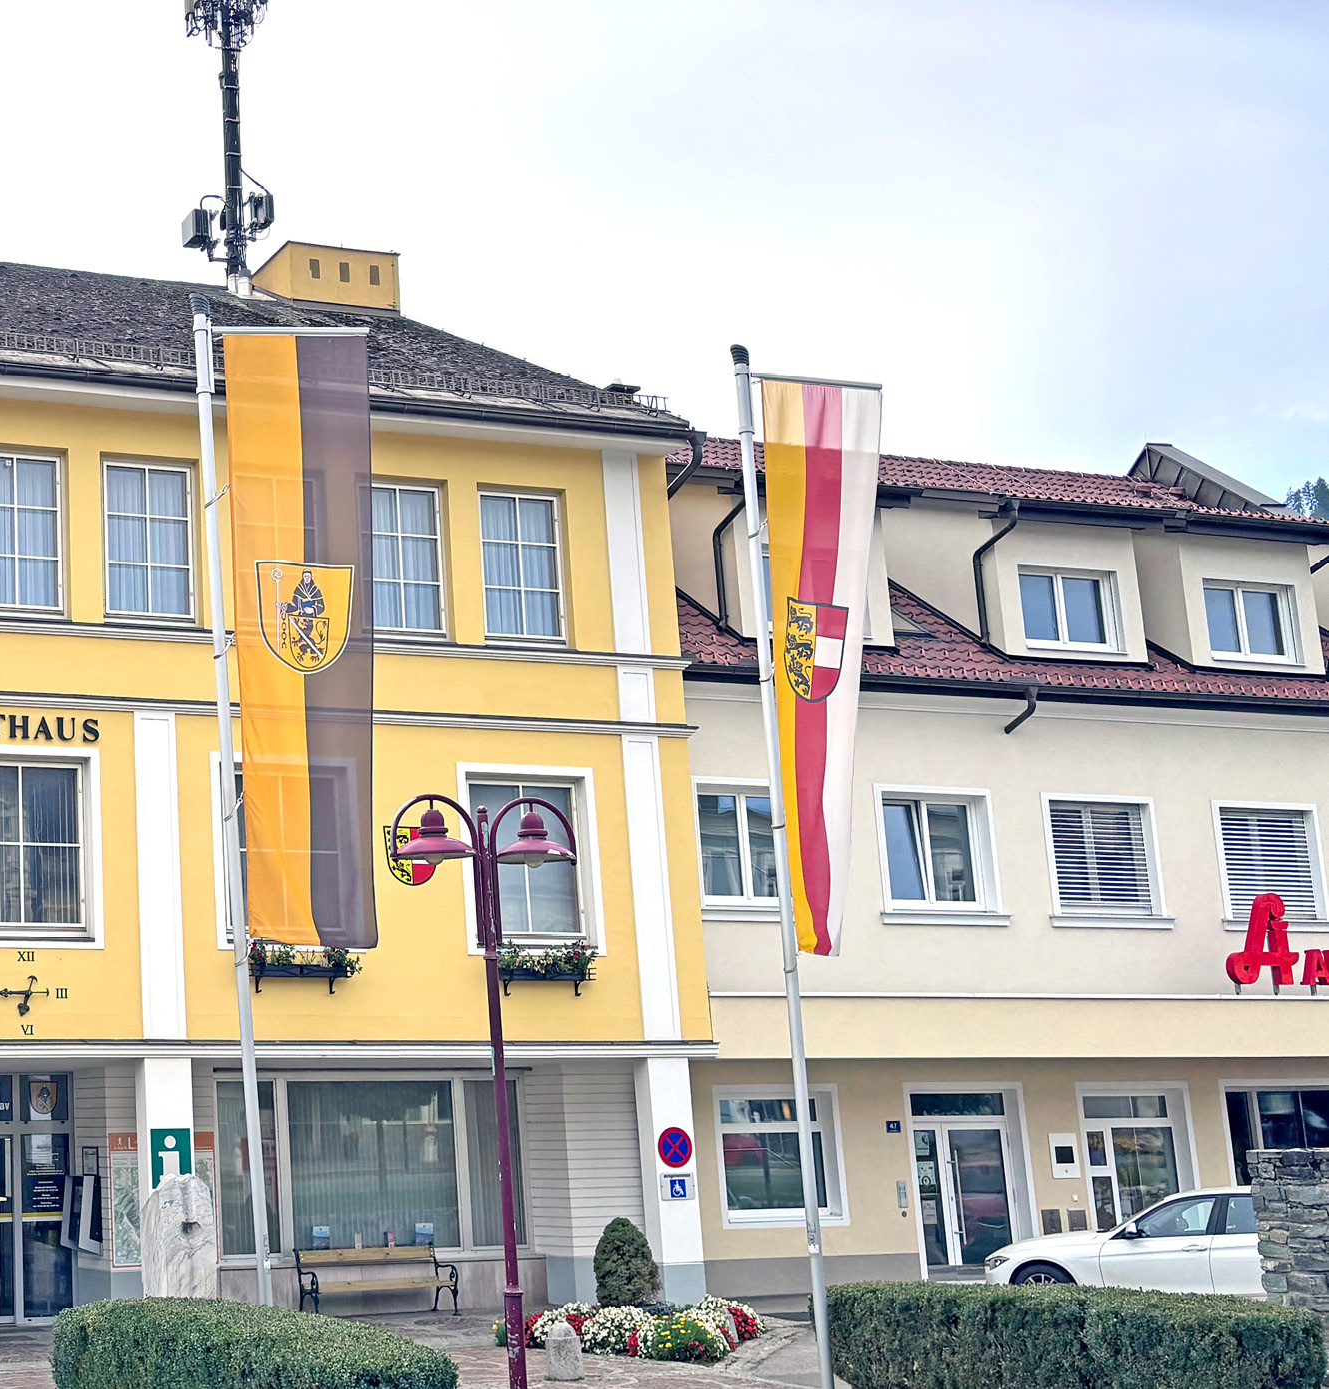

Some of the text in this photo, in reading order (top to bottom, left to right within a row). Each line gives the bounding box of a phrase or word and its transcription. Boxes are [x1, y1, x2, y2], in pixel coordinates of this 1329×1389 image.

[17, 951, 35, 962] XII
[55, 988, 68, 999] III
[21, 1024, 34, 1035] VI
